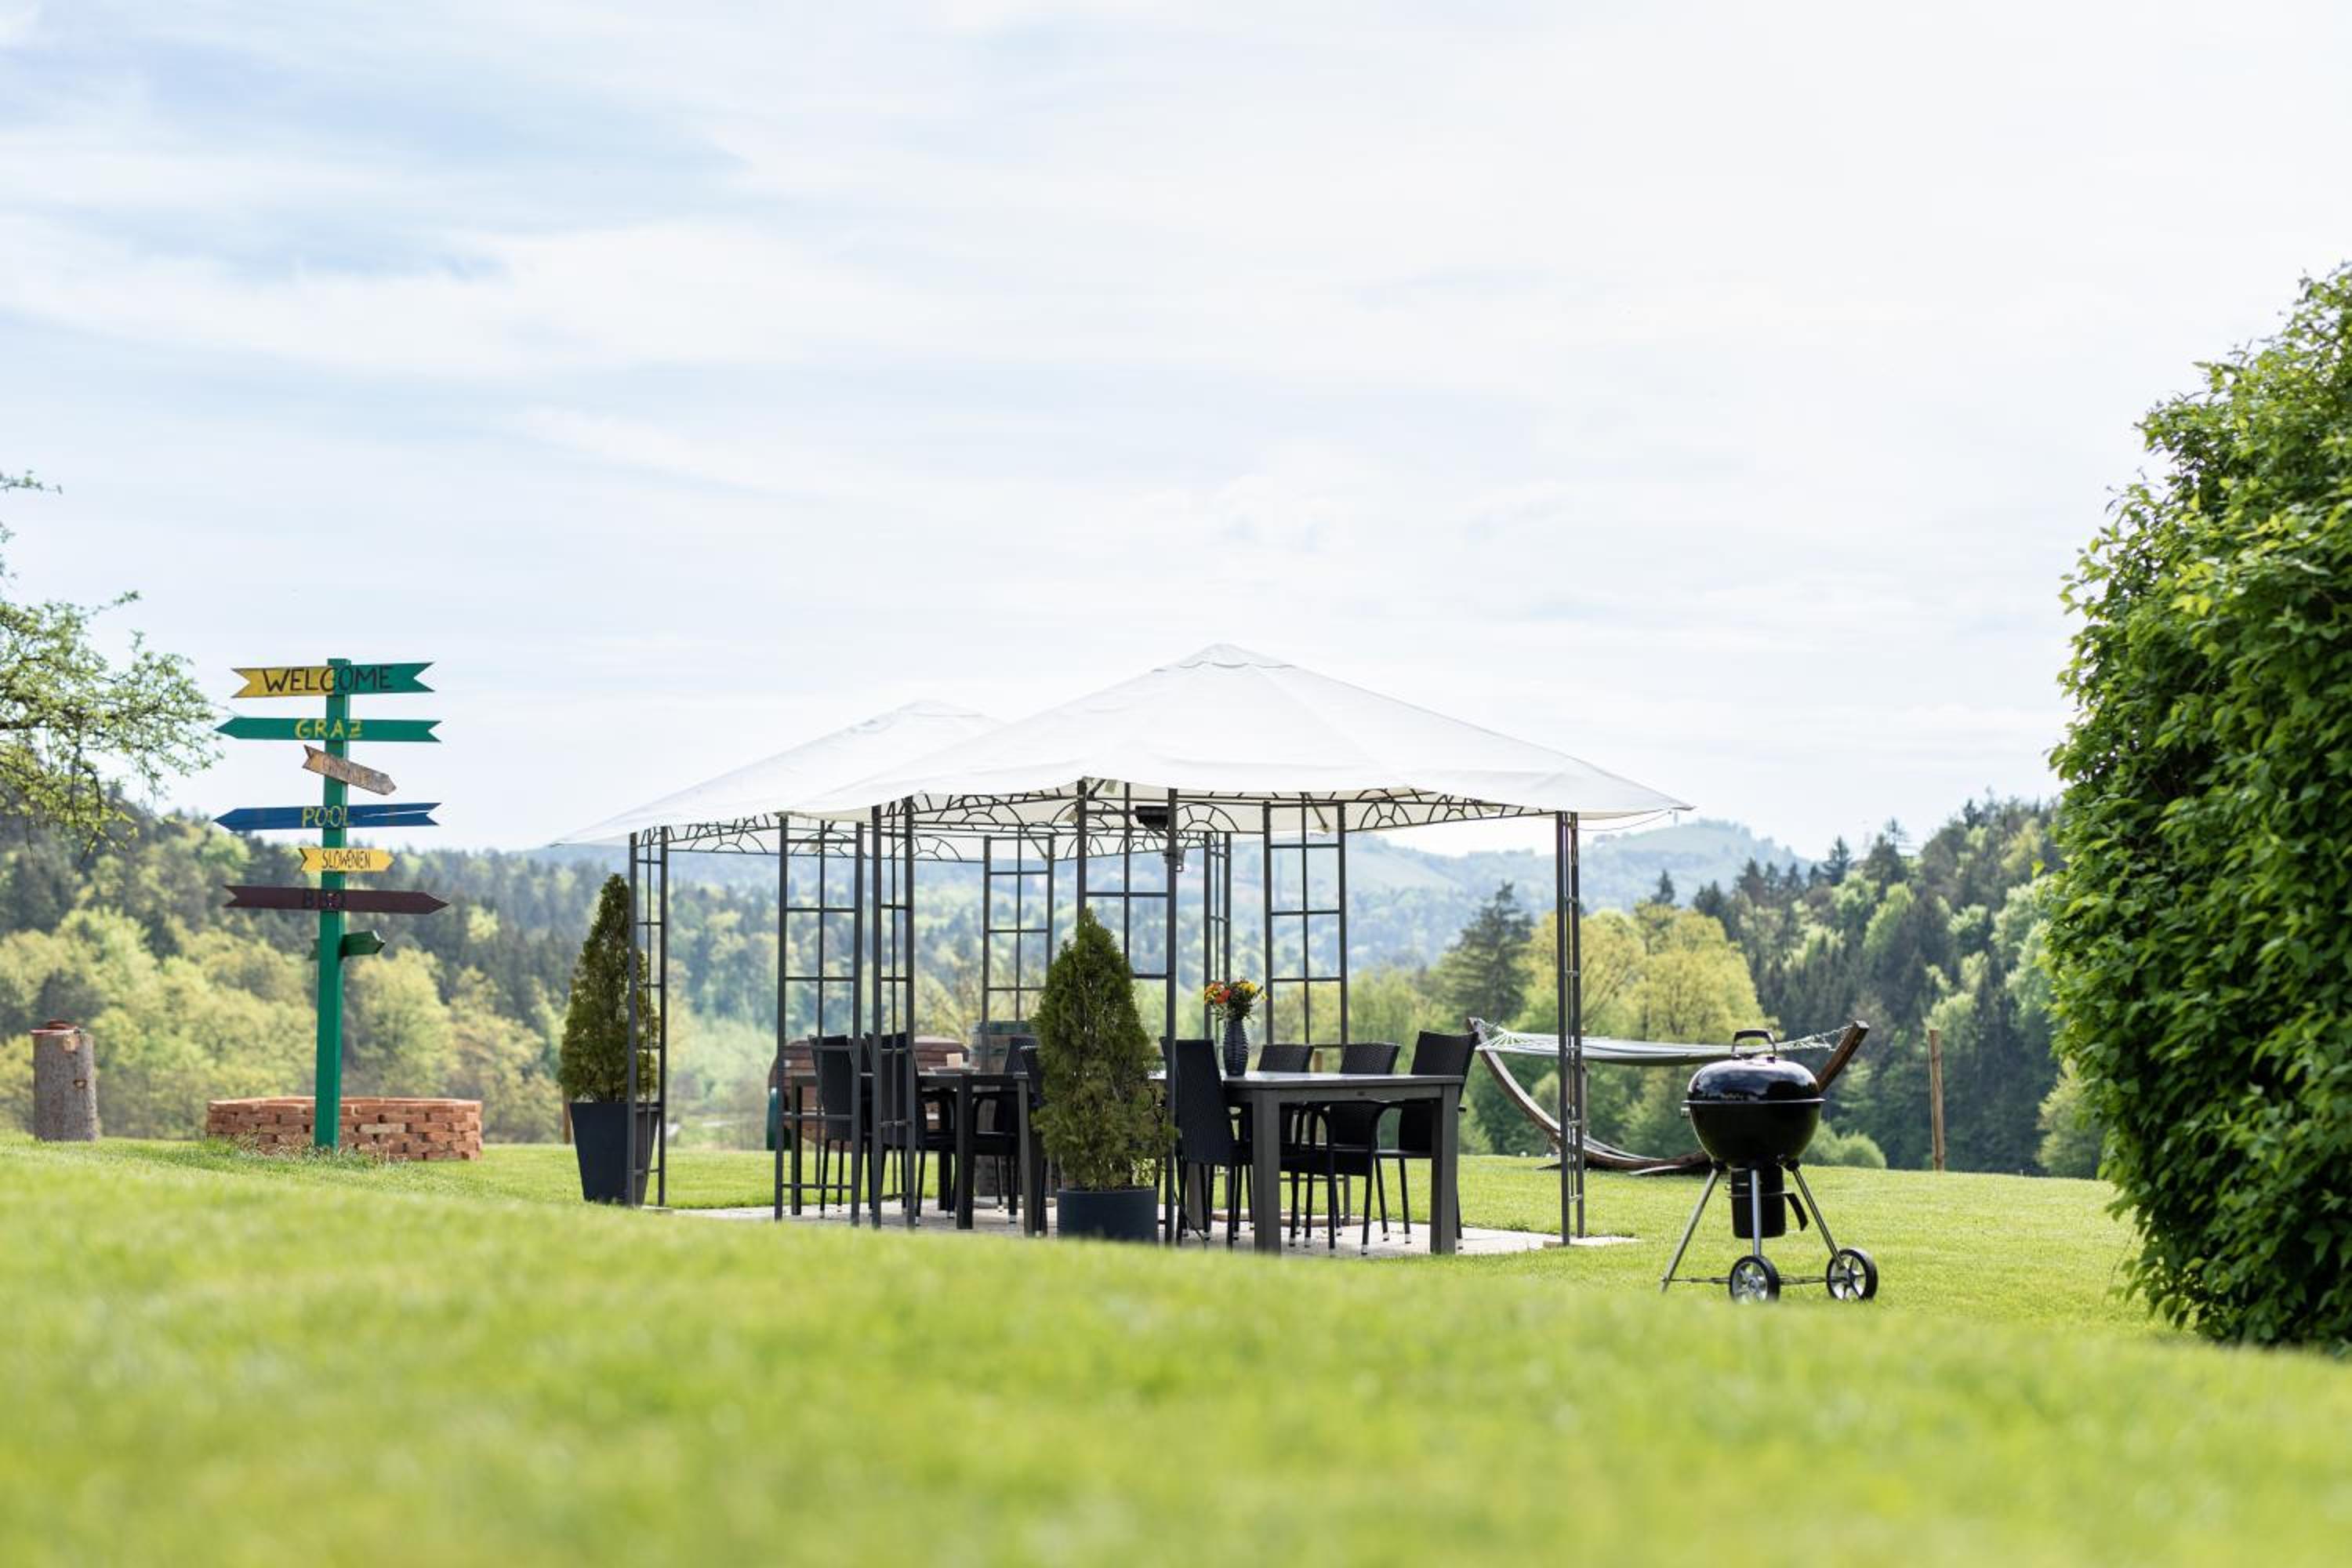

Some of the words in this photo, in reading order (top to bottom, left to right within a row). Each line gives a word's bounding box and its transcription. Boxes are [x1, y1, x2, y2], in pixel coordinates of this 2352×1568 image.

[263, 667, 392, 692] WELCOME
[294, 718, 362, 739] GRAZ
[302, 805, 352, 827] POOL
[322, 850, 371, 869] SLOWENEN
